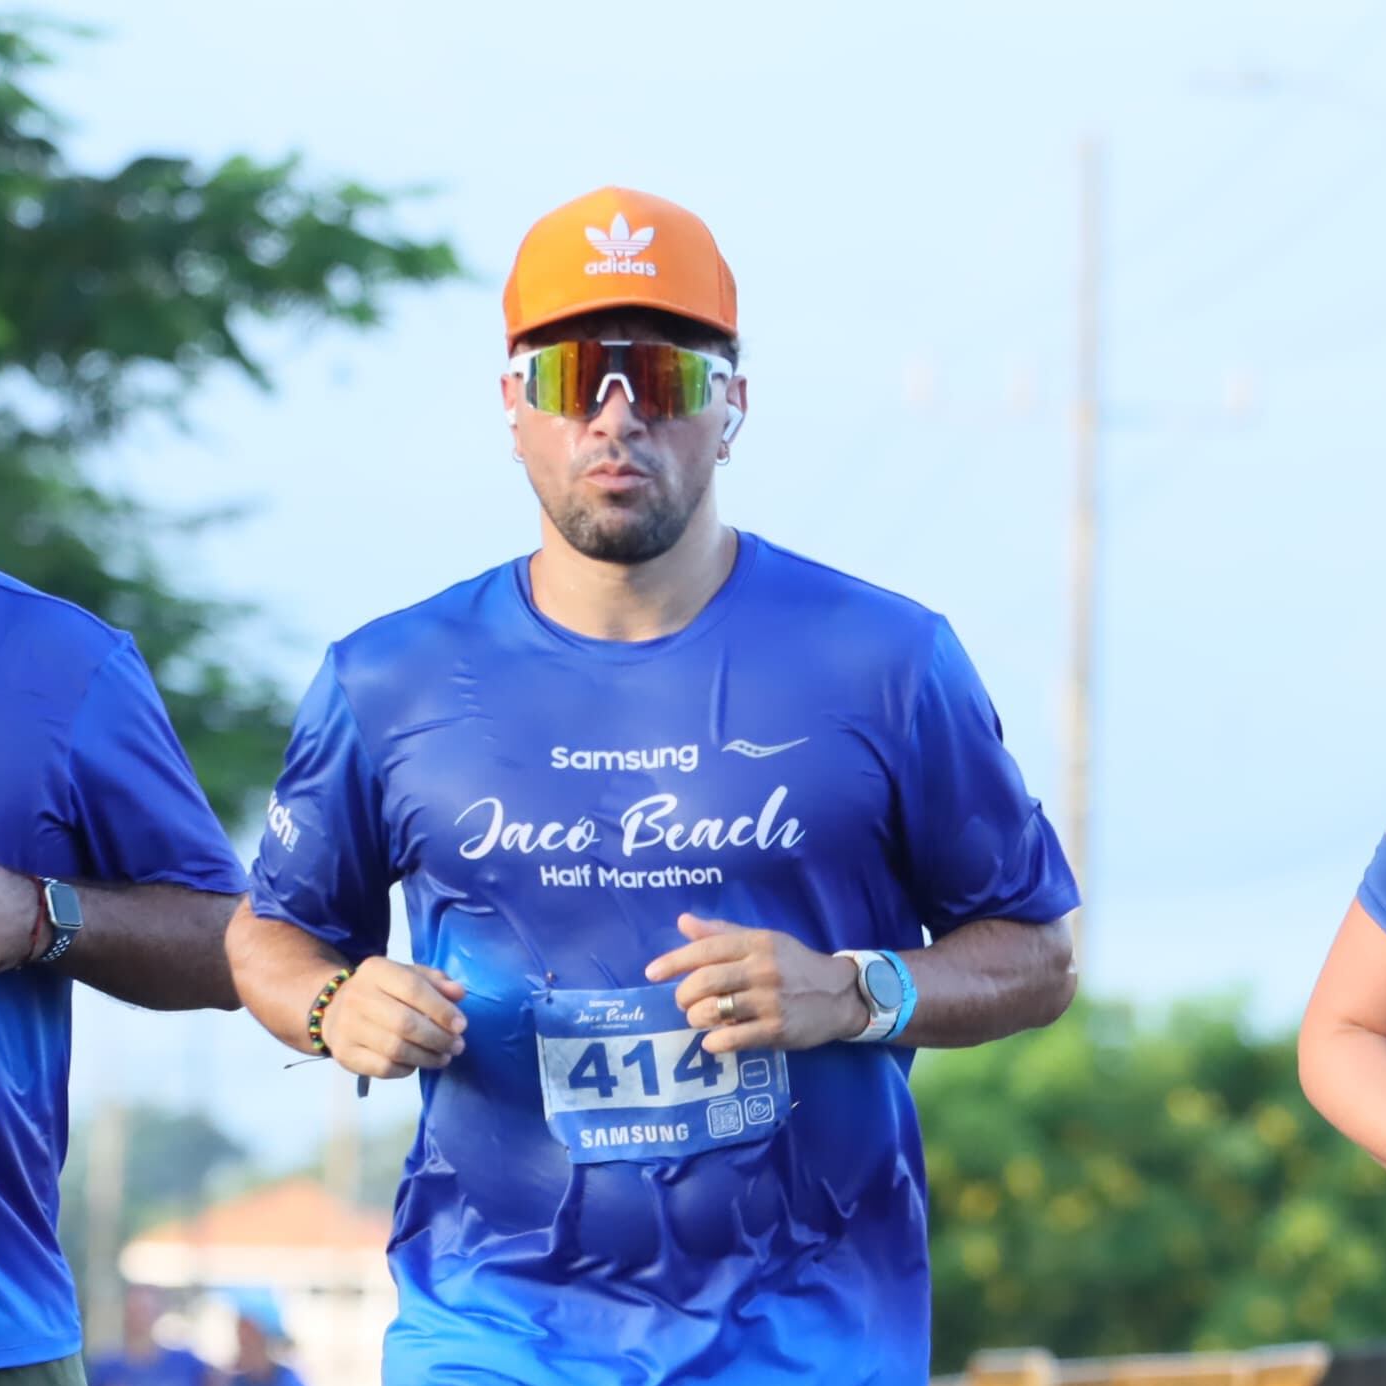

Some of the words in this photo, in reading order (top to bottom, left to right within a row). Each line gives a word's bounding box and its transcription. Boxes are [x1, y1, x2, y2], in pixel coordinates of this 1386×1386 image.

[584, 257, 657, 277] adidas
[550, 744, 699, 772] Samsung
[620, 785, 806, 857] Beach
[540, 865, 591, 887] Half
[598, 865, 723, 888] Marathon
[567, 1031, 723, 1099] 414
[580, 1123, 690, 1149] SAMSUNG
